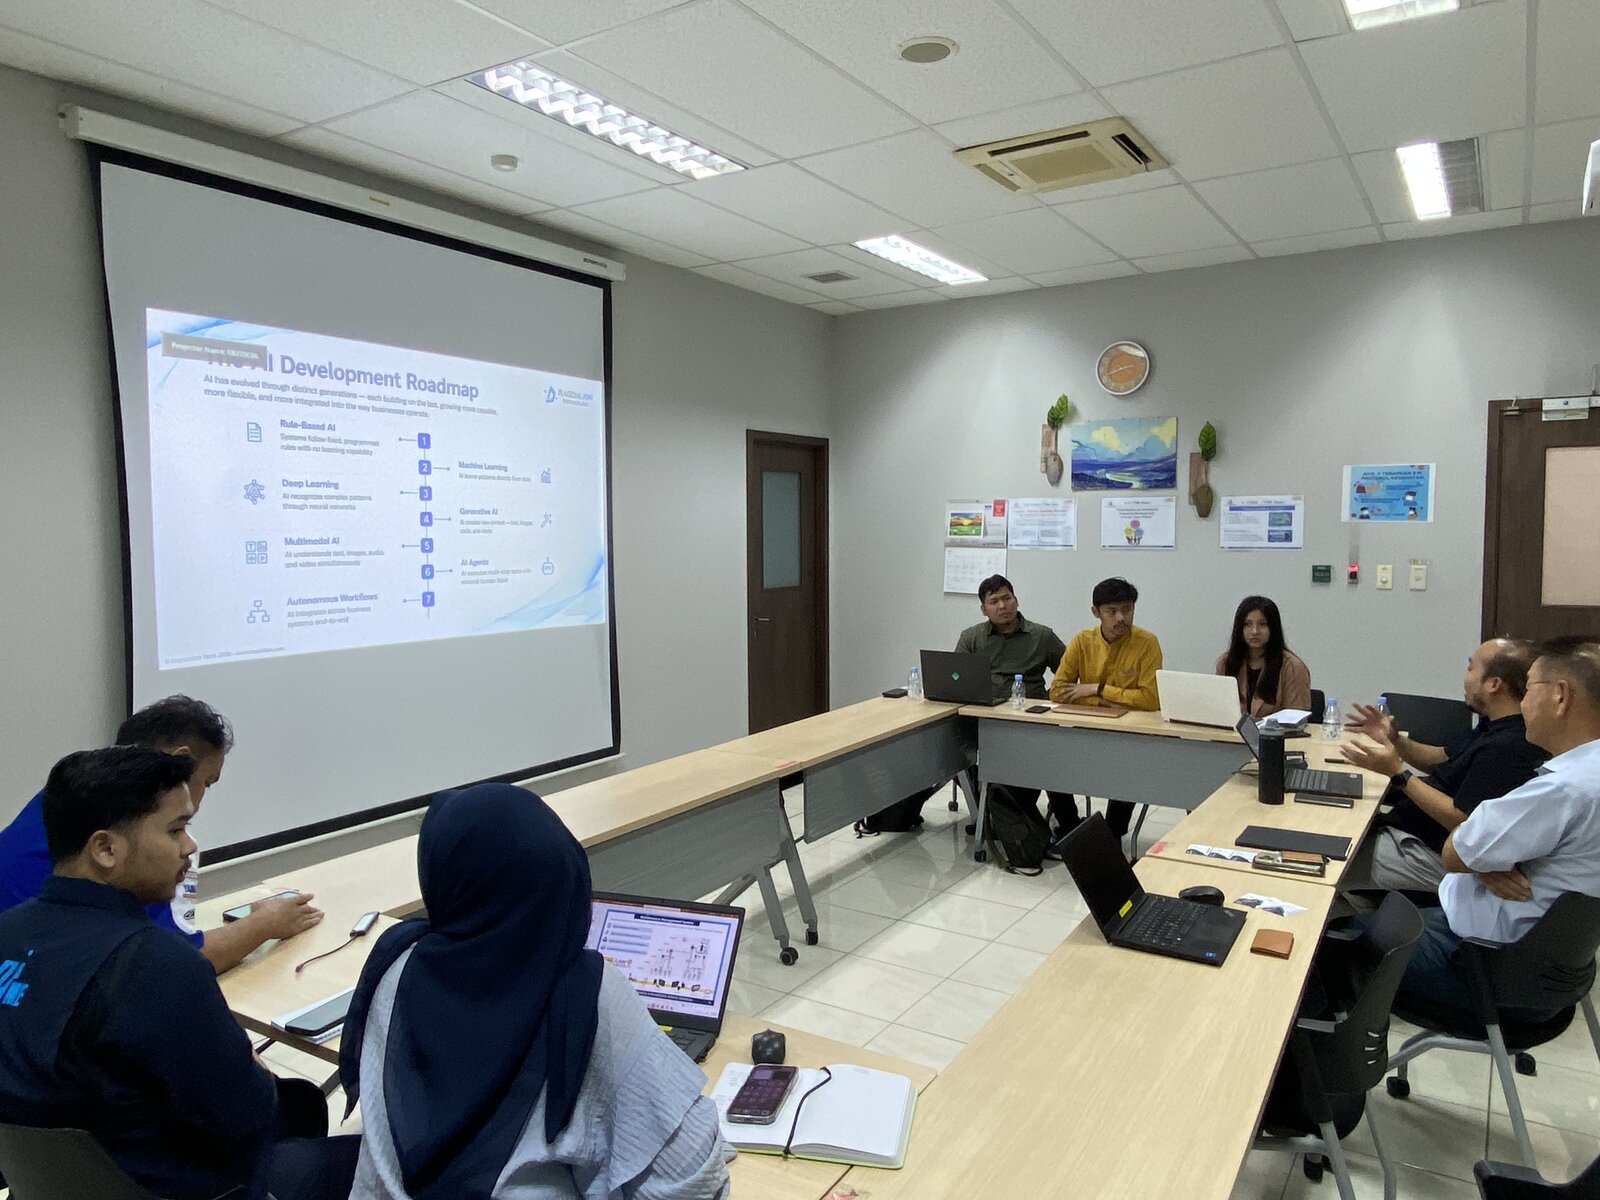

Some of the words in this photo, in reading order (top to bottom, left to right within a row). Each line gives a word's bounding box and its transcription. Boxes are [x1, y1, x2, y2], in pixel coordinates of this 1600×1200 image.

[171, 341, 203, 353] Projector
[280, 354, 402, 388] Development
[406, 372, 479, 401] Roadmap
[204, 374, 213, 383] AI
[214, 375, 229, 385] has
[230, 377, 260, 388] evolved
[261, 381, 290, 393] through
[291, 384, 318, 394] distinct
[383, 395, 407, 406] building
[417, 398, 426, 407] the
[204, 388, 226, 397] more
[227, 389, 257, 401] flexible,
[258, 393, 273, 402] and
[274, 396, 293, 404] more
[294, 396, 330, 408] integrated
[331, 400, 345, 409] into
[345, 401, 356, 410] the
[358, 404, 370, 413] way
[280, 419, 325, 431] Rule-Based
[327, 423, 336, 431] AI
[280, 432, 307, 441] Systems
[297, 444, 312, 452] with
[458, 460, 483, 470] Machine
[484, 462, 508, 473] Learning
[282, 478, 304, 489] Deep
[305, 479, 339, 490] Learning
[282, 503, 309, 511] through
[459, 507, 491, 515] Generative
[284, 536, 330, 546] Multimodal
[331, 536, 340, 545] AI
[285, 560, 298, 569] and
[298, 560, 317, 568] video
[286, 596, 339, 606] Autonomous
[339, 592, 378, 602] Workflows
